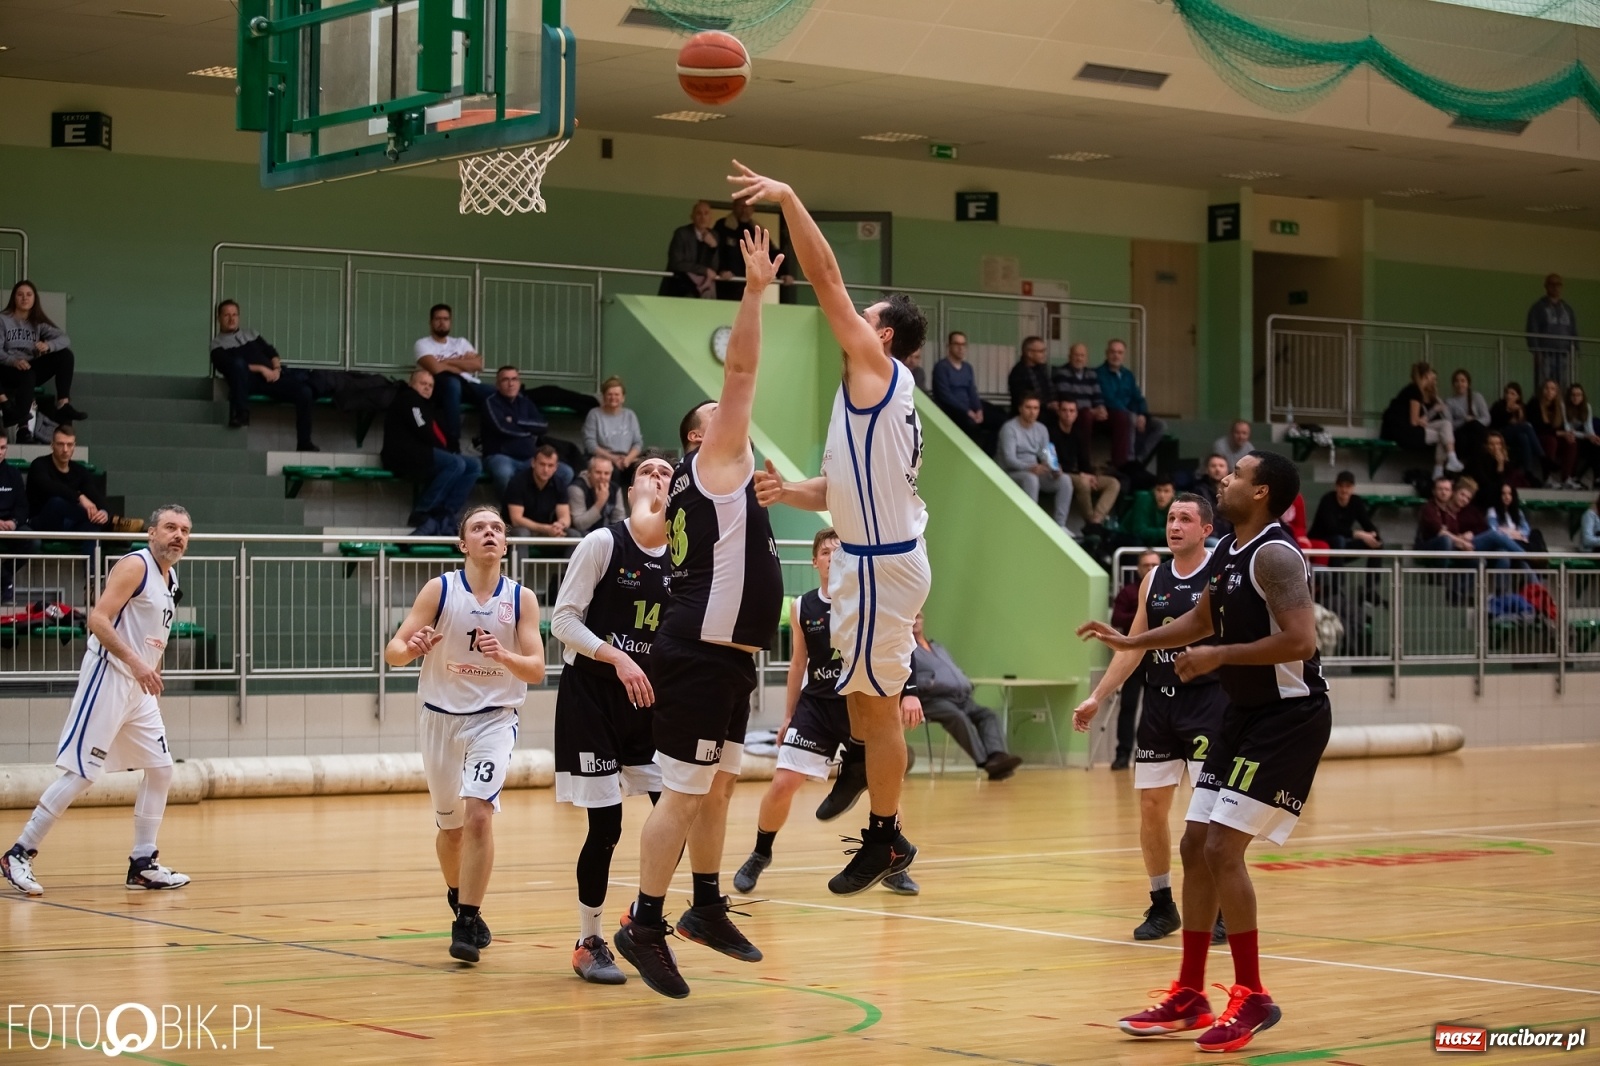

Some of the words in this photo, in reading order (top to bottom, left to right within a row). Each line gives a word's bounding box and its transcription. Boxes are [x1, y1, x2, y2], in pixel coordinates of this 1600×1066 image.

[64, 123, 87, 143] E
[102, 125, 110, 147] E
[967, 201, 987, 219] F
[1216, 216, 1233, 237] F
[617, 576, 641, 587] Cieszyn
[162, 607, 174, 630] 12
[633, 600, 662, 632] 14
[461, 668, 497, 676] KAMPKA
[473, 761, 496, 783] 13
[1227, 756, 1260, 792] 11
